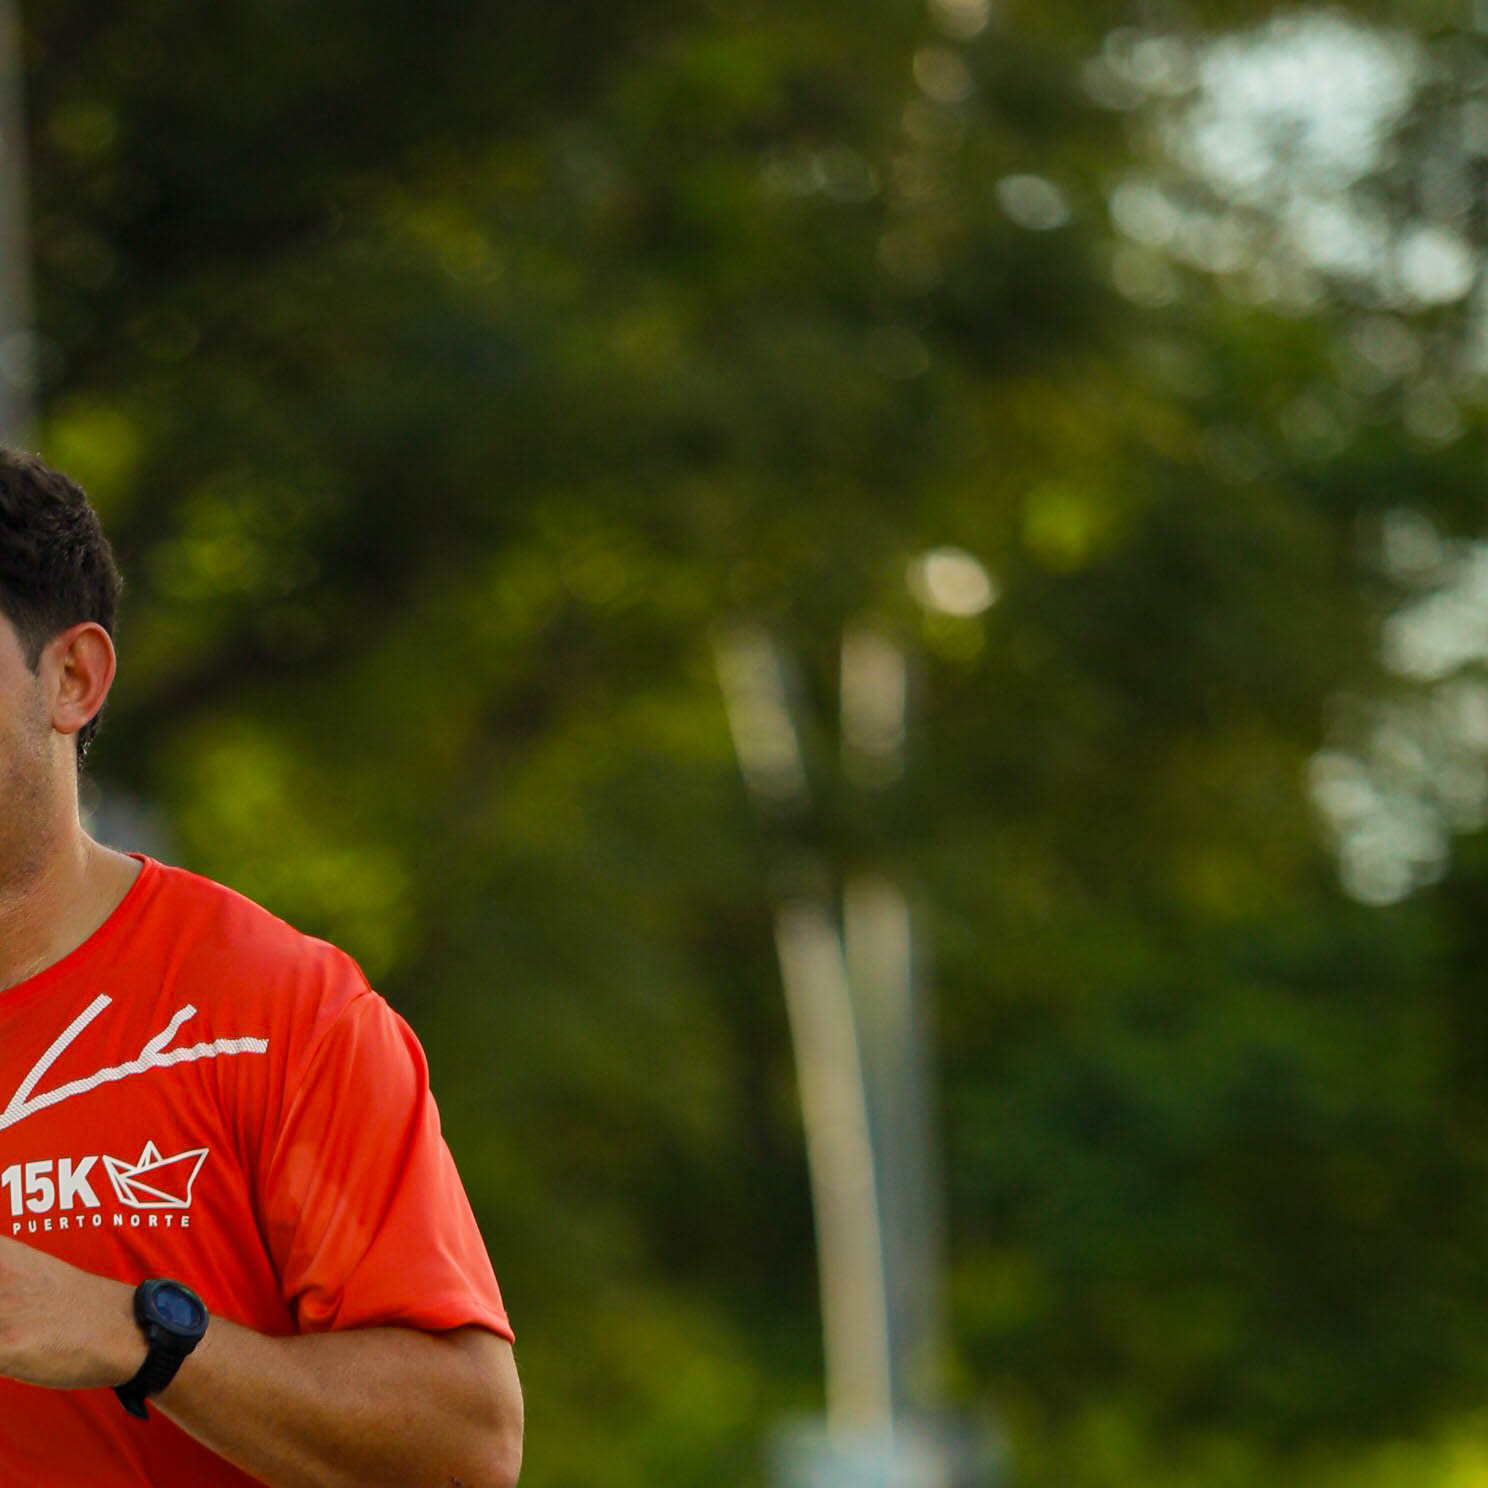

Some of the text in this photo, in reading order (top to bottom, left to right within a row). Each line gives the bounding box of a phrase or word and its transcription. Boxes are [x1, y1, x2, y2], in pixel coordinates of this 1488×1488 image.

[1, 1155, 101, 1216] 15K
[13, 1214, 189, 1236] PUERTO NORTE
